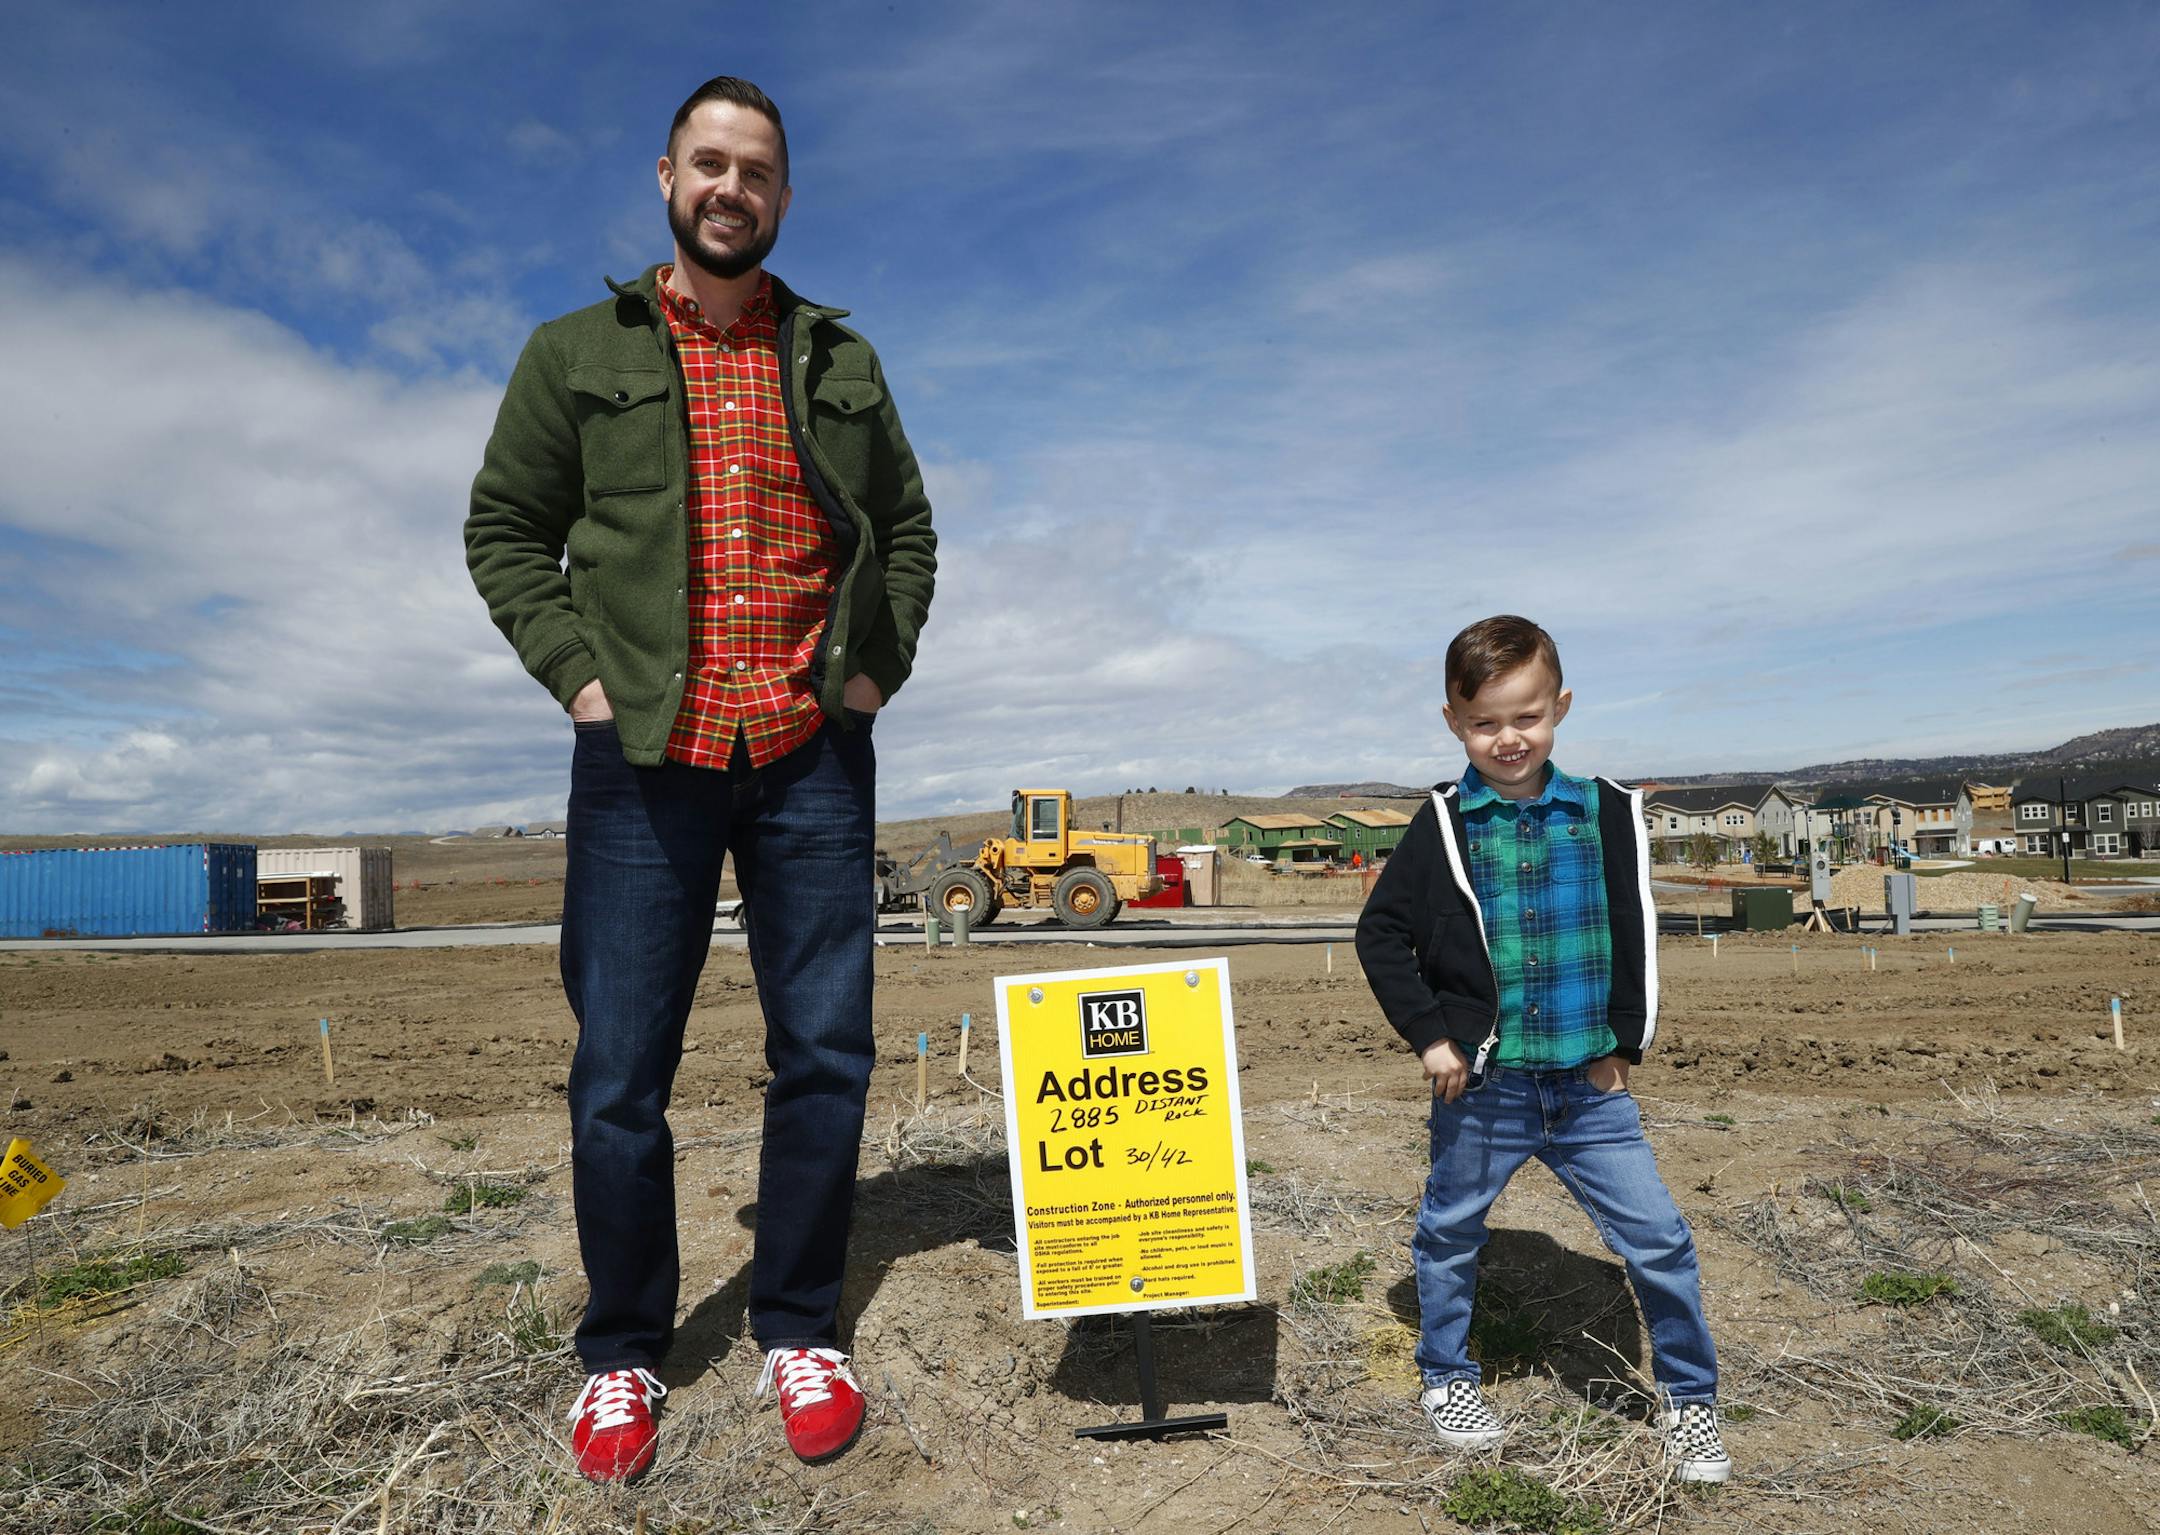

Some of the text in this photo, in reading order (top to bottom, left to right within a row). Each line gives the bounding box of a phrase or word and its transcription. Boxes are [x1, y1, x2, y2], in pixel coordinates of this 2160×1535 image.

[1088, 999, 1139, 1031] KB
[1089, 1031, 1141, 1048] HOME
[1036, 1066, 1209, 1104] Address
[1050, 1094, 1209, 1133] 2885 DISTANT
[12, 1154, 48, 1184] BURIED
[1038, 1137, 1104, 1172] Lot
[1125, 1141, 1193, 1172] 30/42
[8, 1170, 30, 1188] GAS
[1027, 1203, 1089, 1216] Construction
[1092, 1201, 1115, 1211] Zone
[1125, 1196, 1170, 1208] Authorized
[1172, 1192, 1213, 1207] personnel
[1216, 1191, 1235, 1203] only.
[1028, 1221, 1055, 1229] Visitors
[1057, 1219, 1074, 1227] must
[1075, 1218, 1084, 1226] be
[1086, 1214, 1131, 1225] accompanied
[1133, 1213, 1141, 1222] by
[1149, 1211, 1160, 1219] KB
[1183, 1206, 1236, 1217] Representative.
